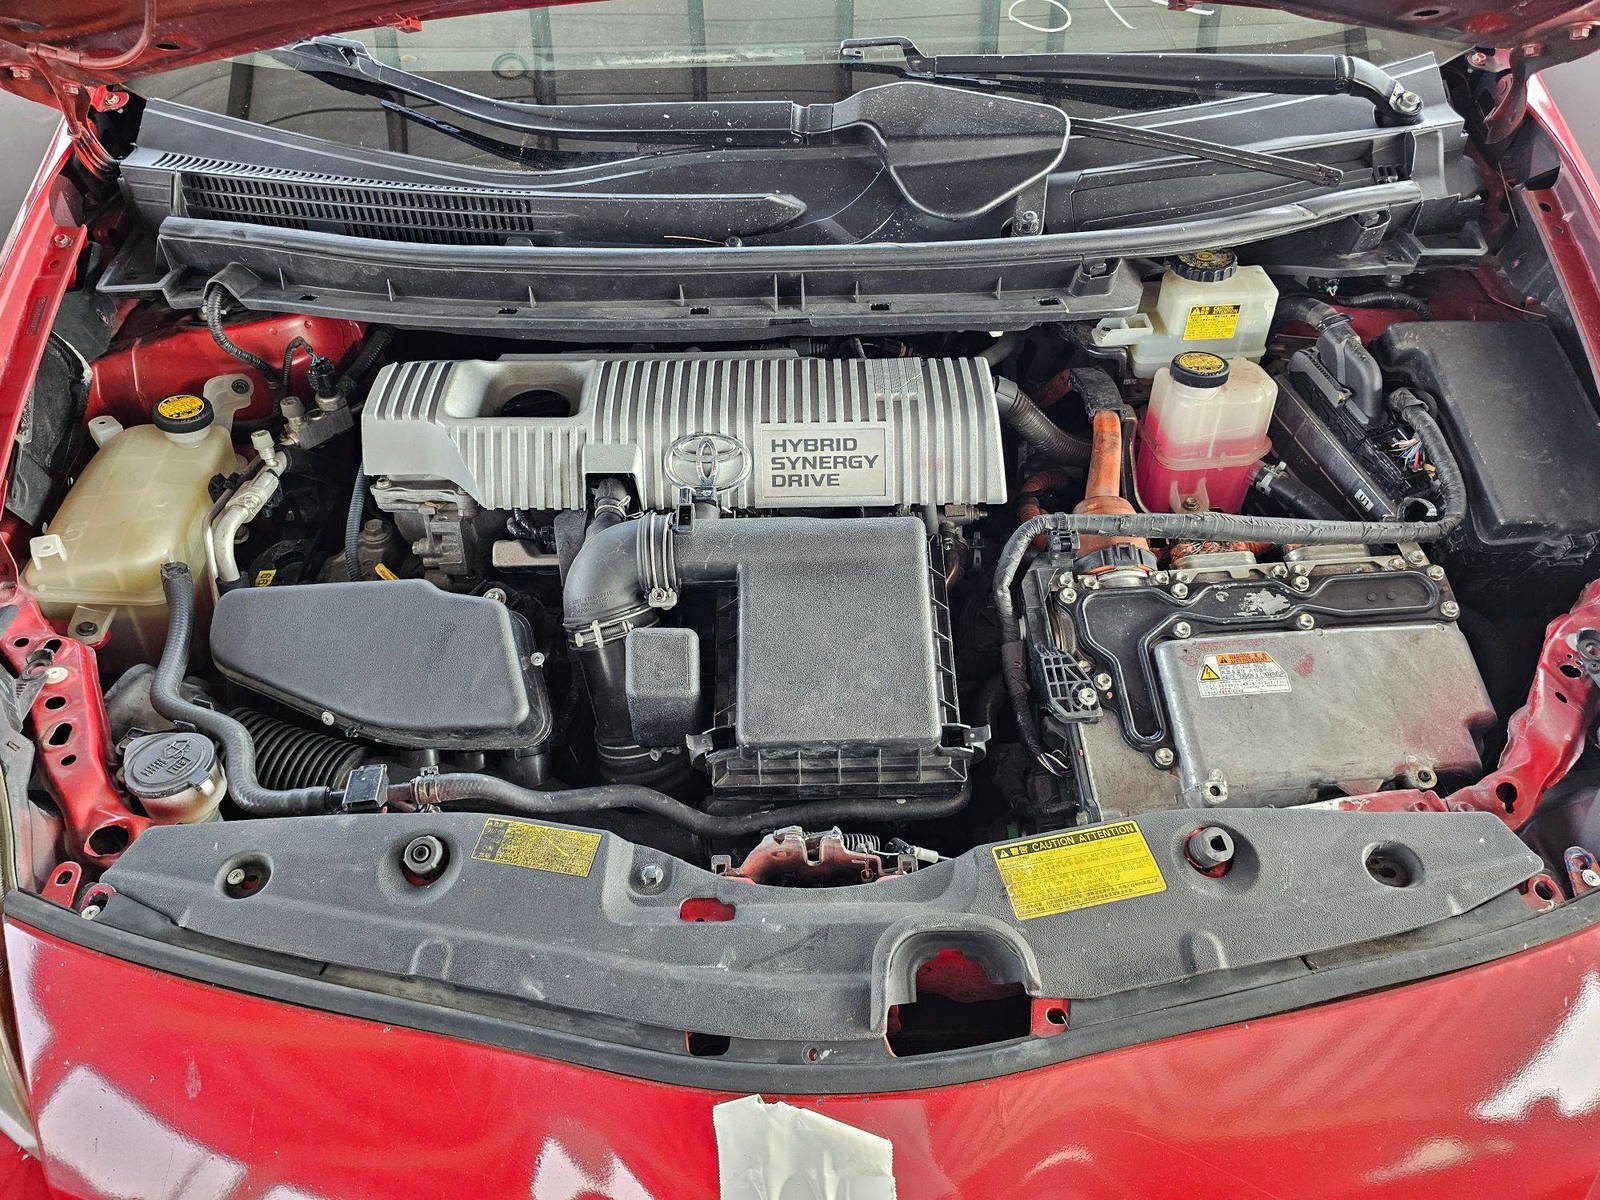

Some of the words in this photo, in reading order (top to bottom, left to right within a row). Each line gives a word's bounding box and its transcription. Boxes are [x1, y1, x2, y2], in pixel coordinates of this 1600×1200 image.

[771, 438, 858, 452] HYBRID
[771, 455, 879, 470] SYNERGY
[771, 473, 840, 488] DRIVE
[1031, 836, 1075, 852] CAUTION
[1079, 825, 1134, 843] ATTENTION
